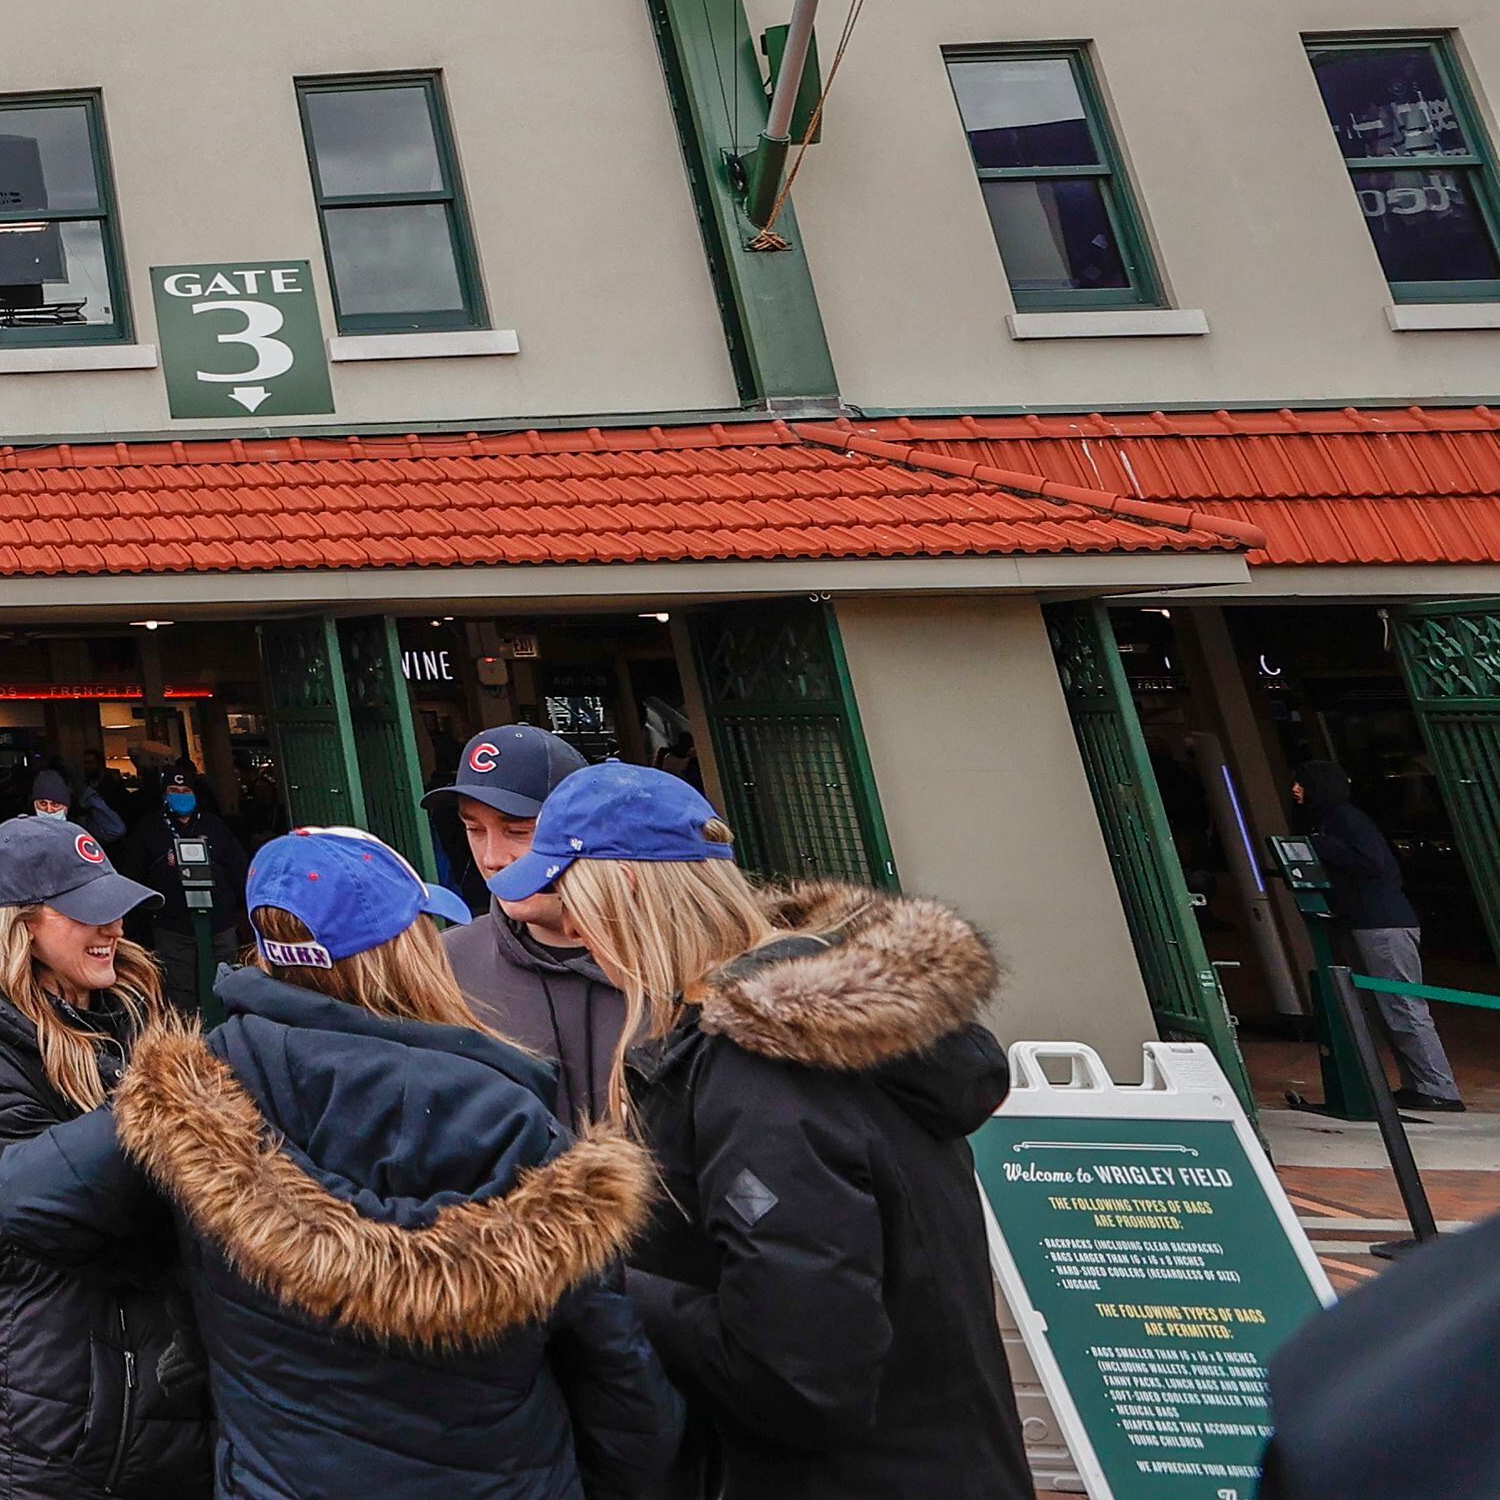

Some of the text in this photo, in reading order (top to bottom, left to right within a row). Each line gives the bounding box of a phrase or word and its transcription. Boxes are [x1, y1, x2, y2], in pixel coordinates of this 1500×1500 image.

[163, 268, 302, 297] GATE
[191, 300, 294, 382] 3
[50, 685, 118, 697] FRENCH
[1003, 1162, 1233, 1187] Welcome to WRIGLEY FIELD
[1048, 1197, 1213, 1214] THE FOLLOWING TYPES OF BAGS
[1094, 1215, 1184, 1230] ARE PROHIBITED:
[1044, 1238, 1223, 1254] BACKPACKS (INCLUDING CLEAR BACKPACKS)
[1056, 1265, 1241, 1283] HARD-SIDED COOLERS (REGARDLESS OF SIZE)
[1062, 1279, 1101, 1291] LUGGAGE
[1095, 1303, 1266, 1323] THE FOLLOWING TYPES OF BAGS
[1144, 1322, 1234, 1339] ARE PERMITTED:
[1097, 1360, 1270, 1378] (INCLUDING WALLETS, PURSES, DRAWST
[1102, 1375, 1132, 1387] FANNY
[1132, 1377, 1165, 1389] PACKS,
[1165, 1378, 1194, 1390] LUNCH
[1195, 1380, 1219, 1391] BAGS
[1219, 1381, 1238, 1392] AND
[1109, 1390, 1161, 1402] SOFT-SIDED
[1161, 1392, 1201, 1404] COOLERS
[1201, 1394, 1242, 1406] SMALLER
[1116, 1405, 1180, 1418] MEDICAL BAGS
[1122, 1419, 1155, 1431] DIAPER
[1154, 1420, 1180, 1432] BAGS
[1179, 1421, 1203, 1434] THAT
[1204, 1423, 1257, 1436] ACCOMPANY
[1127, 1433, 1204, 1449] YOUNG CHILDREN
[1136, 1461, 1151, 1472] WE
[1152, 1462, 1203, 1474] APPRECIATE
[1202, 1464, 1228, 1476] YOUR
